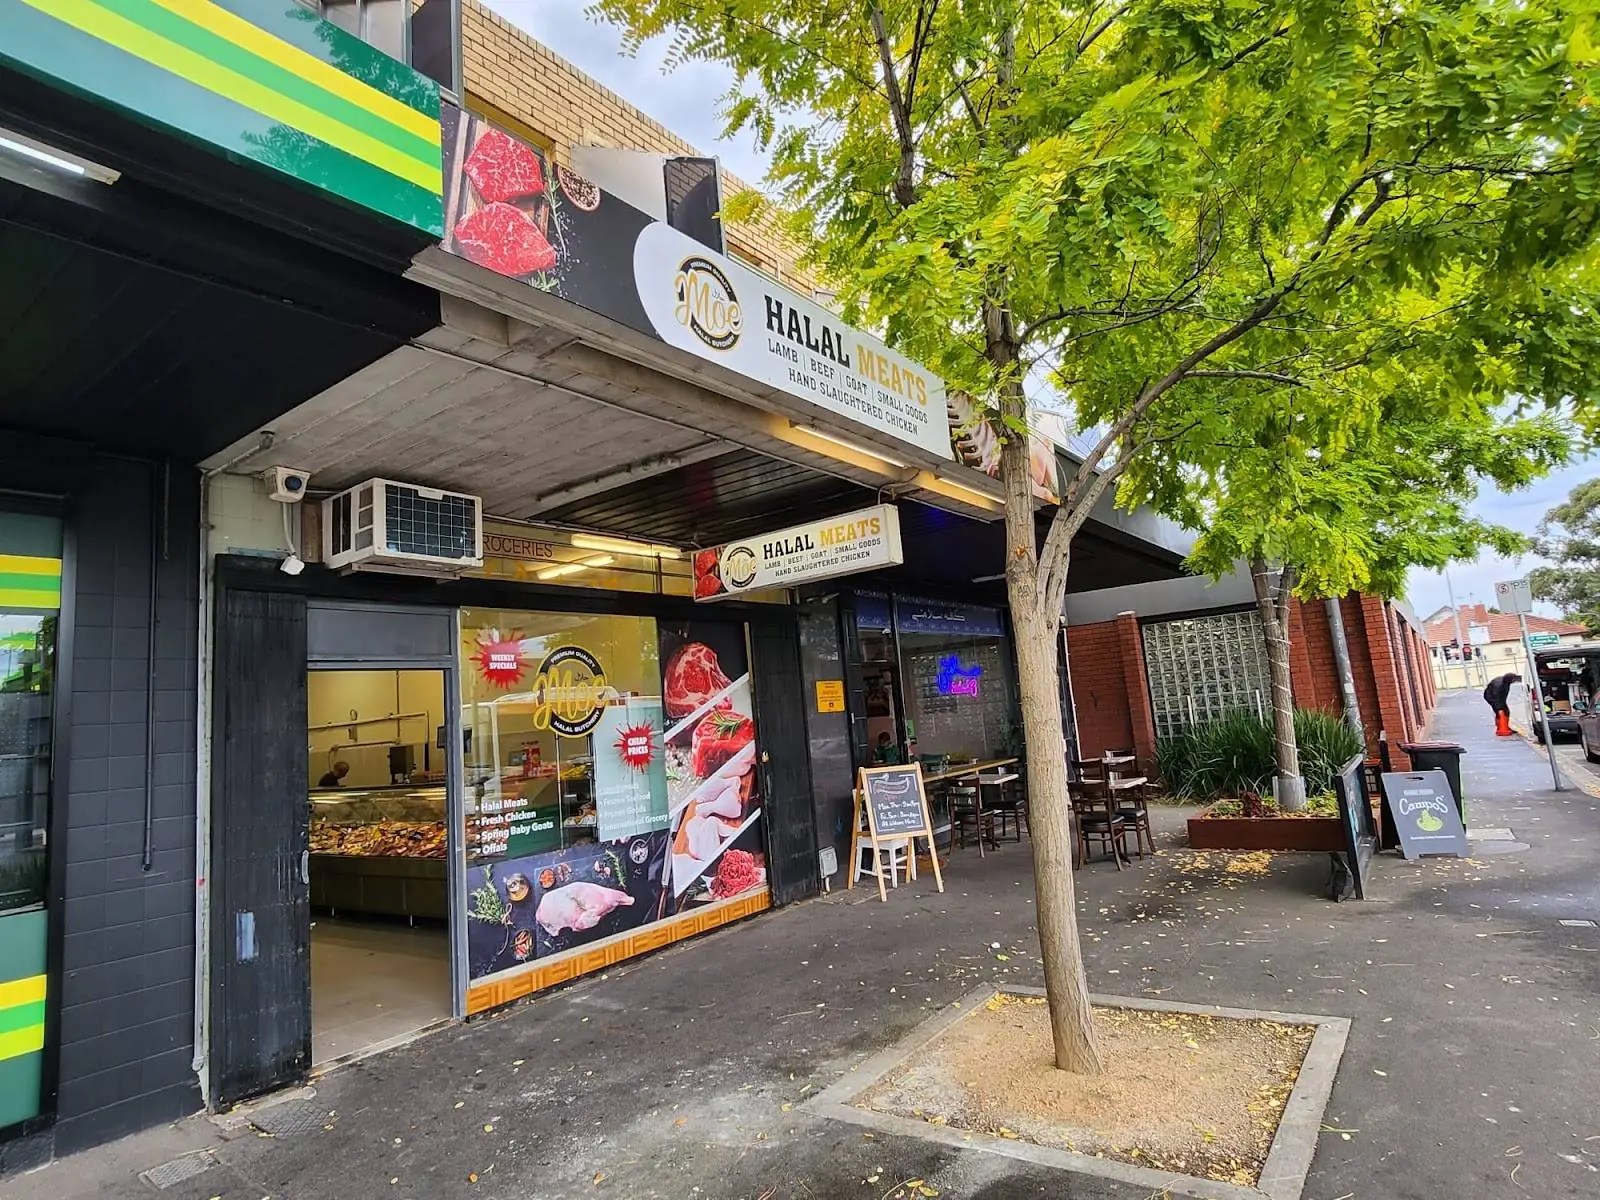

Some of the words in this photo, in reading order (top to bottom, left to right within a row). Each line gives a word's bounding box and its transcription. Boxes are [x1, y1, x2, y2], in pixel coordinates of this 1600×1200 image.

[674, 269, 742, 332] Moe
[764, 294, 851, 369] HALAL
[856, 343, 928, 406] MEATS
[768, 338, 798, 363] LAMB
[810, 358, 835, 380] BEEF
[845, 375, 868, 396] GOAT
[877, 390, 904, 413] SMALL
[905, 404, 928, 424] GOODS
[788, 367, 817, 391] HAND
[819, 381, 884, 421] SLAUGHTERED
[885, 411, 919, 436] CHICKEN
[482, 535, 553, 558] ROCERIES
[763, 534, 814, 560] HALAL
[820, 517, 881, 546] MEATS
[764, 560, 781, 569] LAMB
[811, 550, 827, 559] GOAT
[835, 543, 857, 554] SMALL
[858, 537, 881, 548] GOODS
[775, 567, 791, 577] HAND
[793, 557, 839, 573] SLAUGHTERED
[841, 550, 870, 564] CHICKEN
[489, 661, 517, 670] SPECIALS
[491, 654, 515, 662] WEEKLY
[550, 650, 575, 663] PREMIUM
[575, 651, 596, 668] QUALITY
[553, 720, 573, 733] HALAL
[574, 709, 600, 733] BUTCHERY
[627, 736, 648, 746] CHEAP
[627, 745, 649, 756] PRICES
[481, 800, 502, 812] Halal
[503, 798, 528, 809] Meats
[481, 813, 504, 826] Fresh
[505, 810, 537, 822] Chicken
[644, 814, 668, 824] Grocery
[481, 828, 510, 842] Spring
[510, 824, 531, 836] Baby
[531, 821, 554, 832] Goats
[482, 842, 508, 854] Offals
